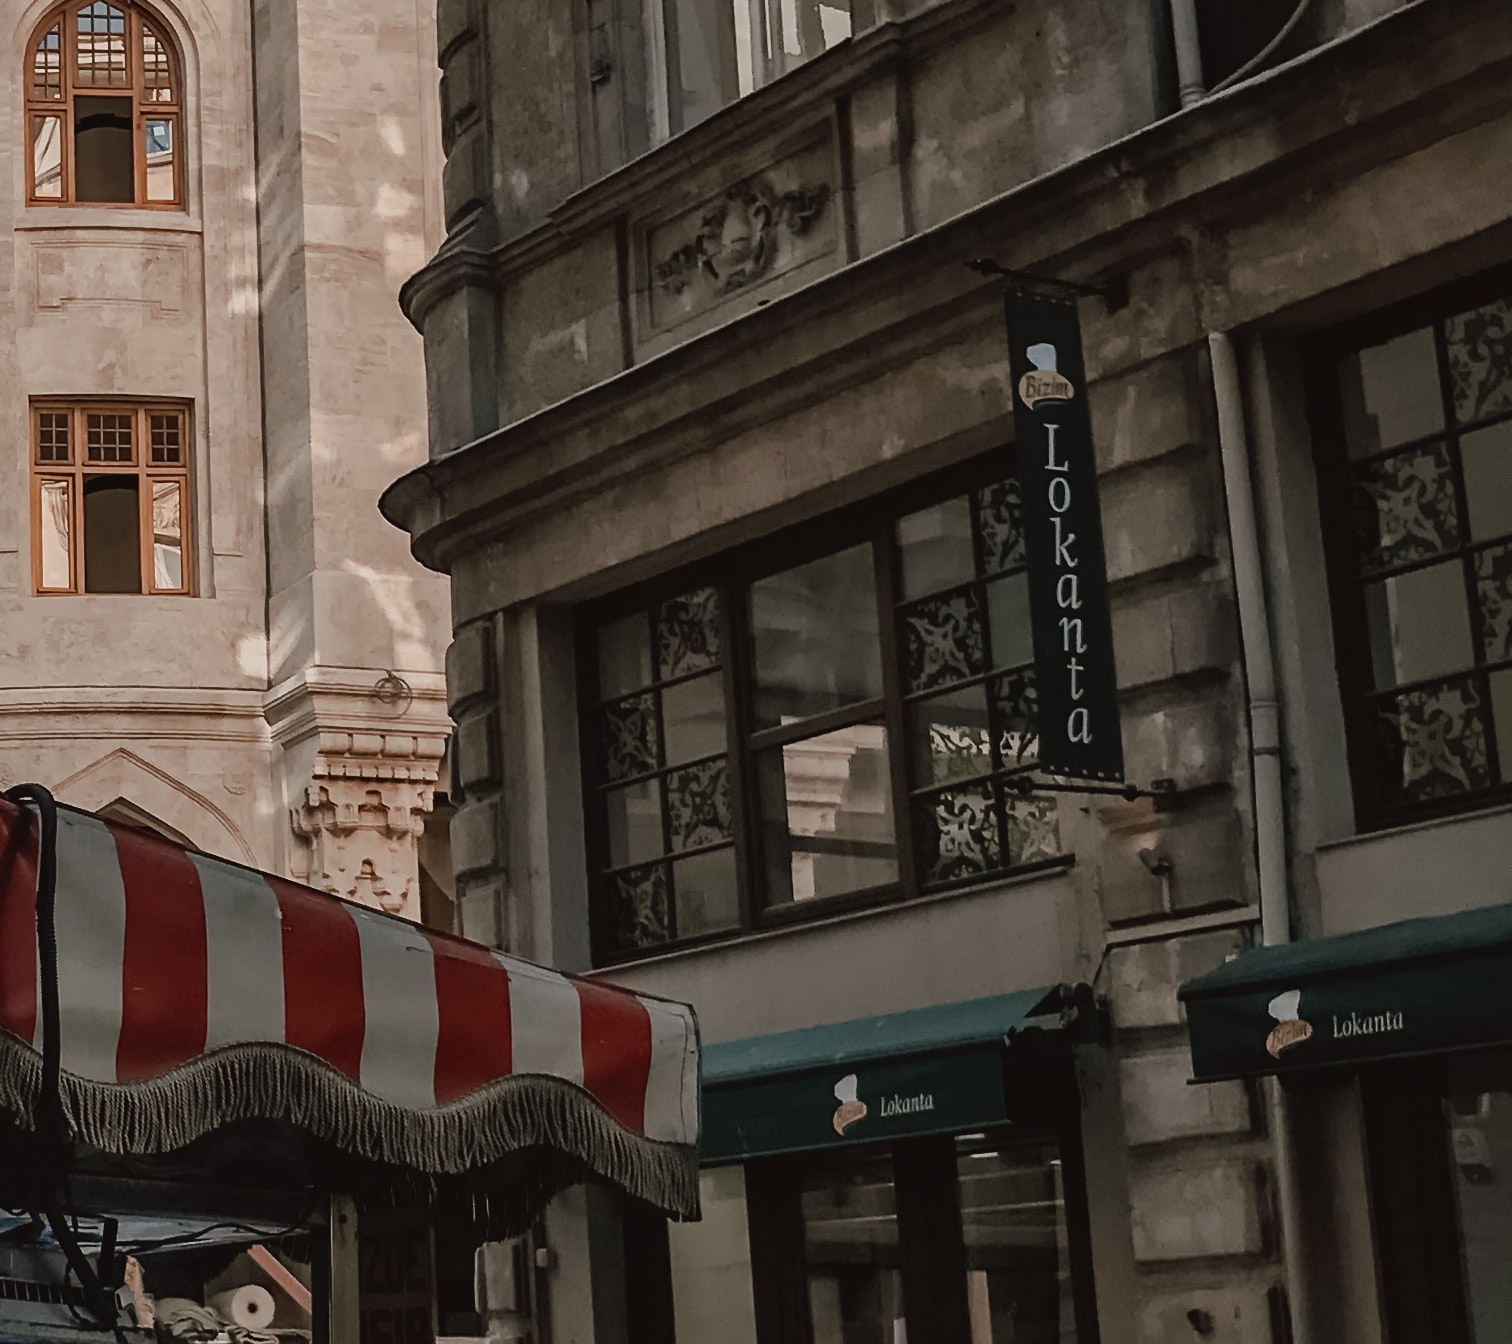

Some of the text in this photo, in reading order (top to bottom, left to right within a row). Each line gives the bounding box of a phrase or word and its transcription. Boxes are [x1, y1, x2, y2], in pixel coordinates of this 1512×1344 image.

[1043, 423, 1093, 744] Lokanta
[1332, 1010, 1404, 1038] Lokanta
[880, 1092, 934, 1117] Lokanta
